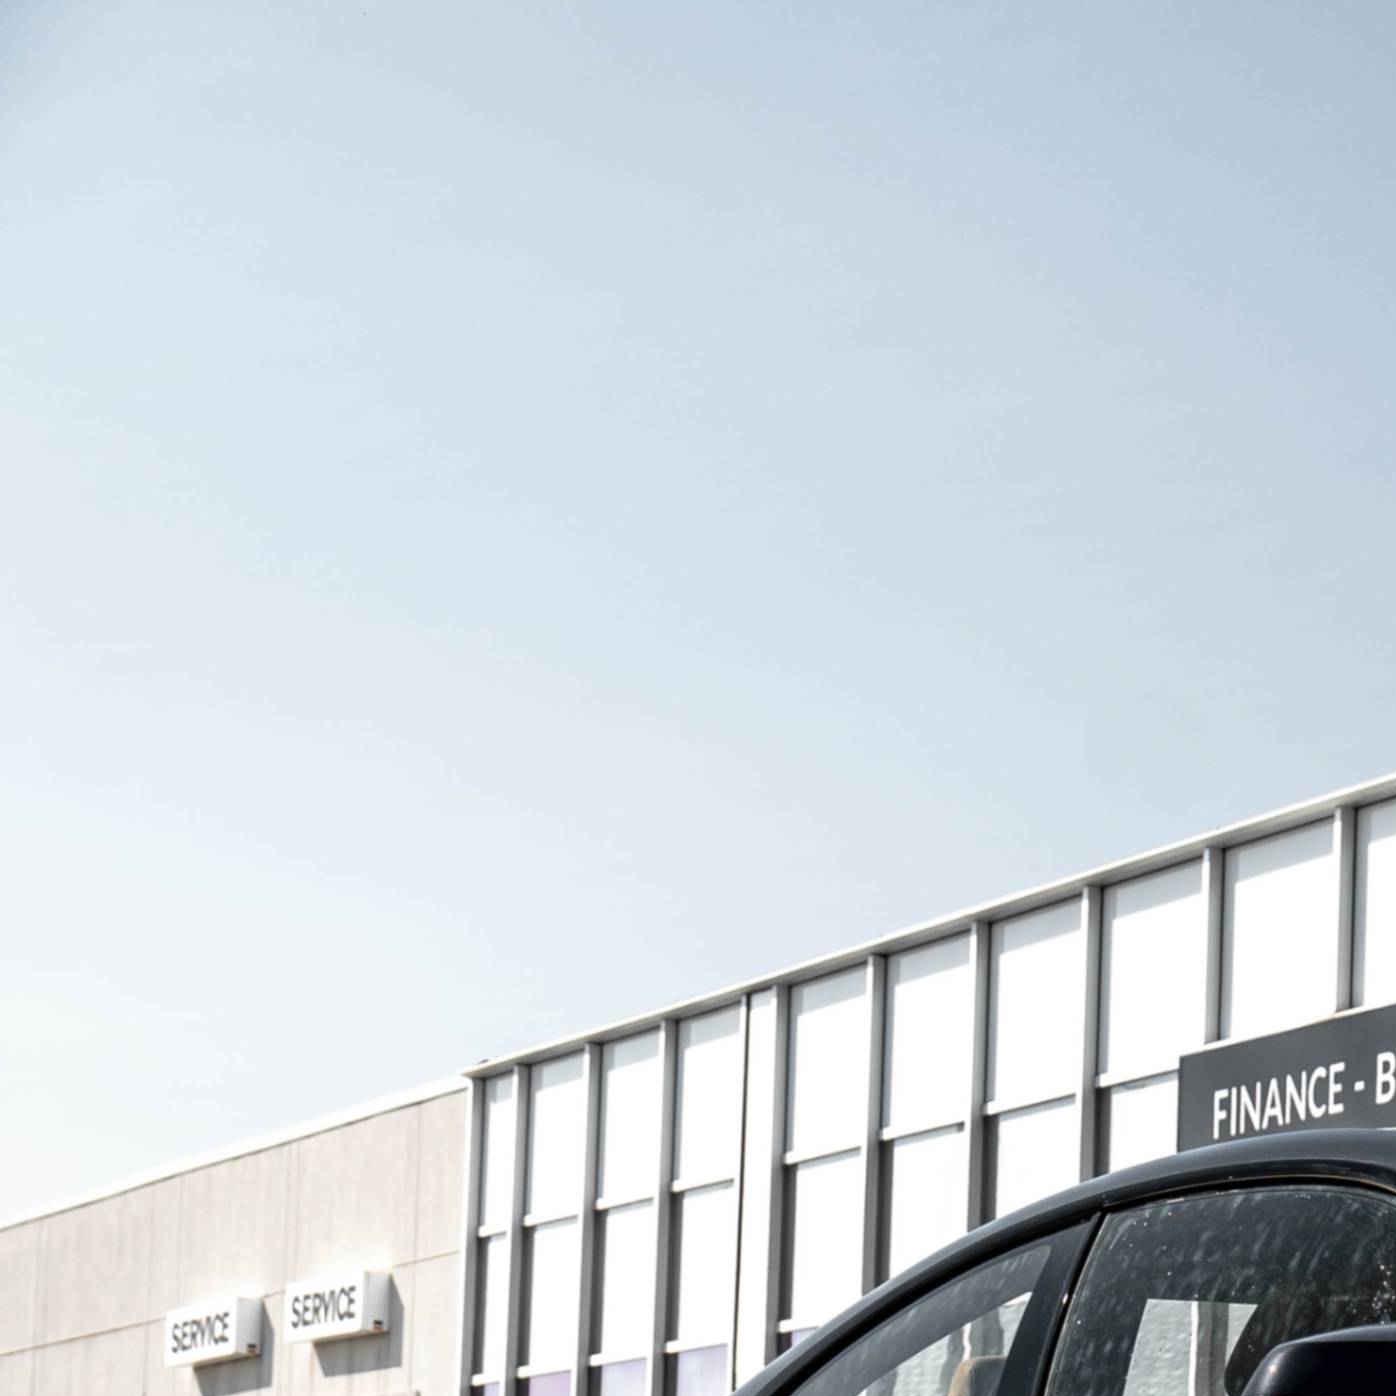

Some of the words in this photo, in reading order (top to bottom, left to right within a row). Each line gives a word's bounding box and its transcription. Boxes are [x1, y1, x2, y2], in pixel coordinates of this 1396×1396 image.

[1212, 1061, 1346, 1140] FINANCE
[290, 1285, 357, 1329] SERVICE
[171, 1312, 230, 1354] SERVICE
